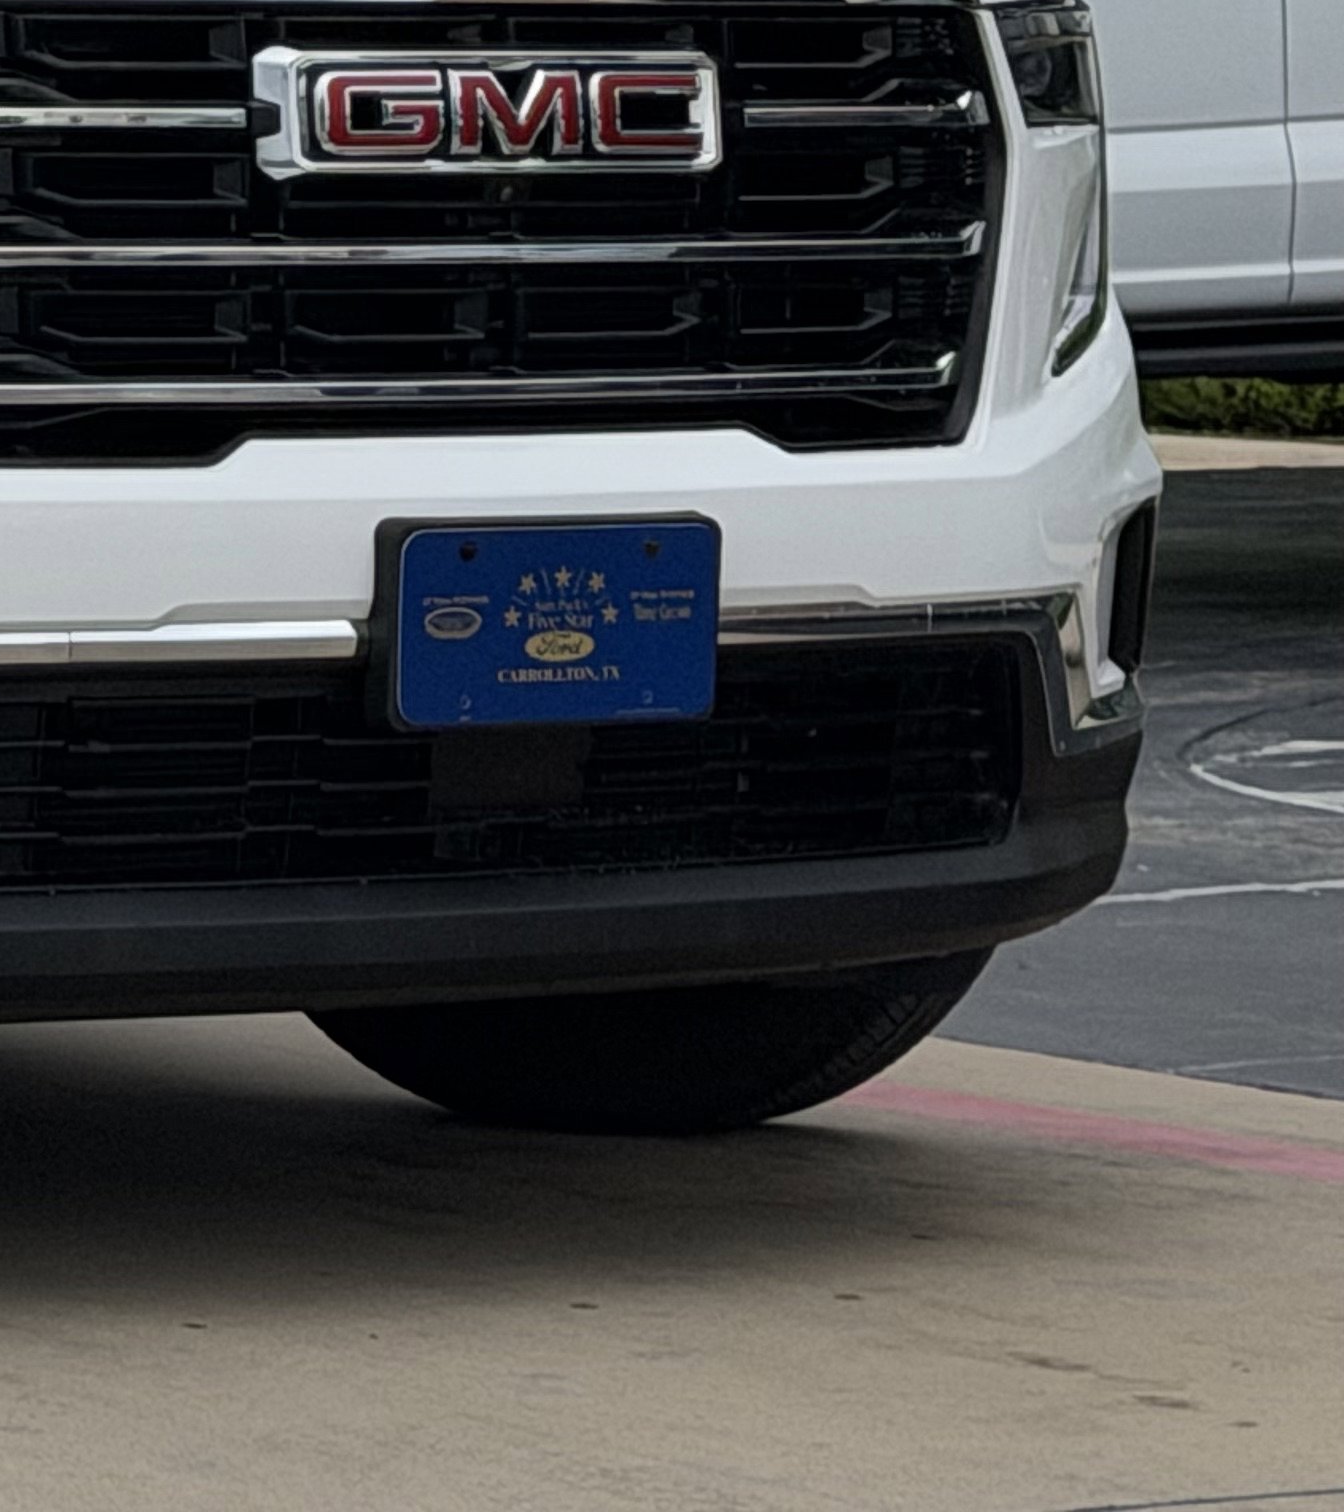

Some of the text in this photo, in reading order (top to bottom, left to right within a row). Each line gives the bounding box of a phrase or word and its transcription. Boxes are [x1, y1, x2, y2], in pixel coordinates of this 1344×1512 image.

[315, 69, 706, 156] GMC
[527, 611, 595, 630] Five Star
[535, 631, 584, 656] Ford
[497, 665, 621, 683] CARROLLTON, TX
